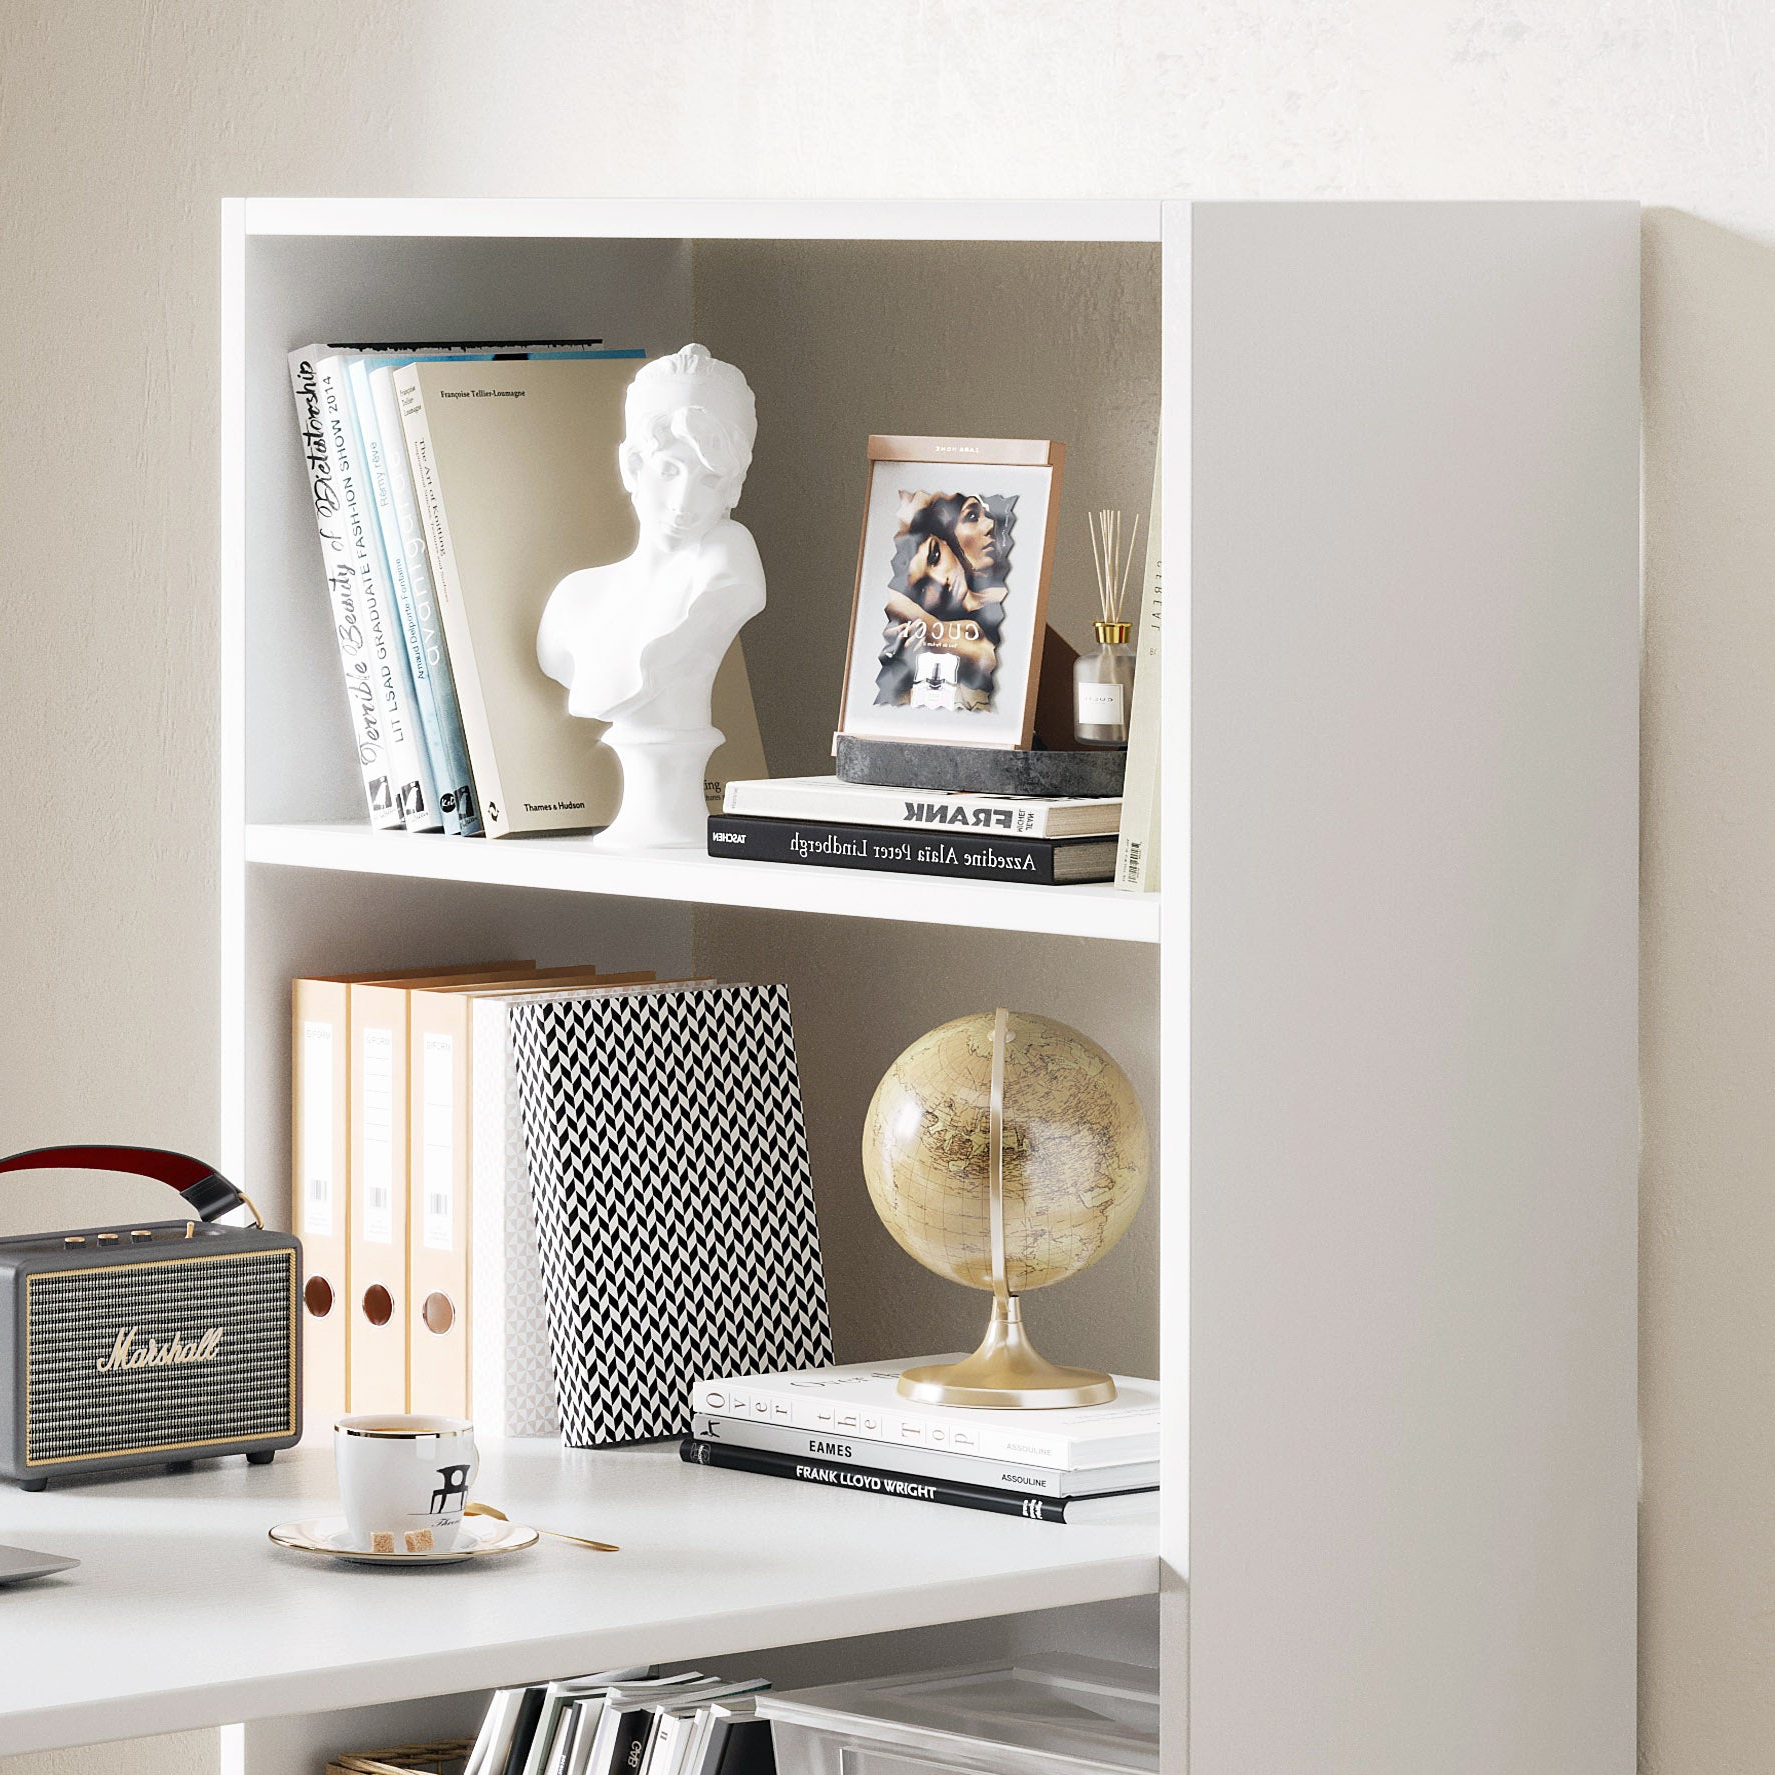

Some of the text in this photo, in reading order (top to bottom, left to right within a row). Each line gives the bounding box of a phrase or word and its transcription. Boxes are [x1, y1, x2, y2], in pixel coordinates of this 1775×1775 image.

[322, 375, 339, 413] 2014
[330, 419, 350, 472] SHOW
[523, 802, 553, 812] Thames
[559, 800, 585, 811] Hudson
[96, 1325, 224, 1372] Marshall
[796, 1465, 937, 1500] FRANK LLOYD WRIGHT
[808, 1440, 1047, 1488] EAMES ASSOULINE
